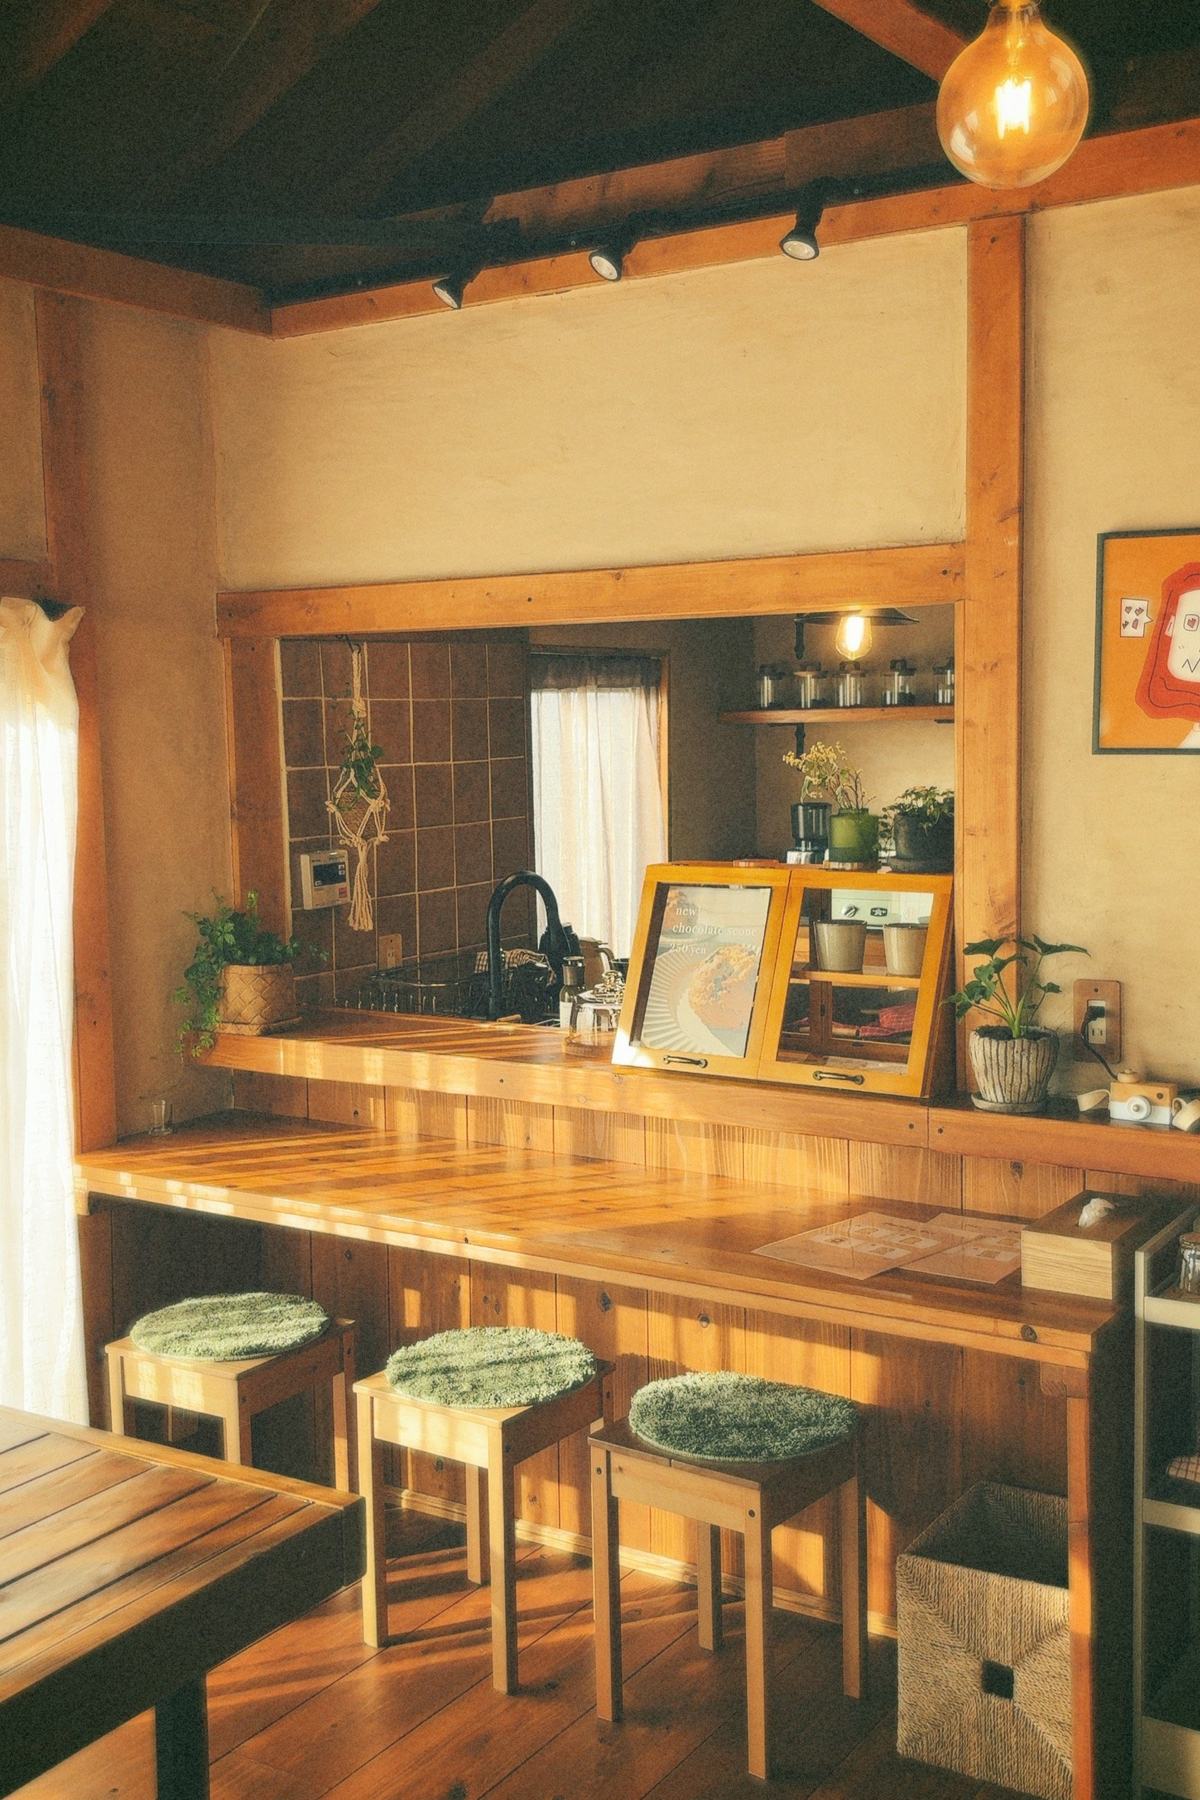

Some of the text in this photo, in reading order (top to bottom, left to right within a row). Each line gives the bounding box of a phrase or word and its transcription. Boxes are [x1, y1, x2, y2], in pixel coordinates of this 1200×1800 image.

[675, 907, 696, 916] new
[672, 922, 757, 936] chocolate scone
